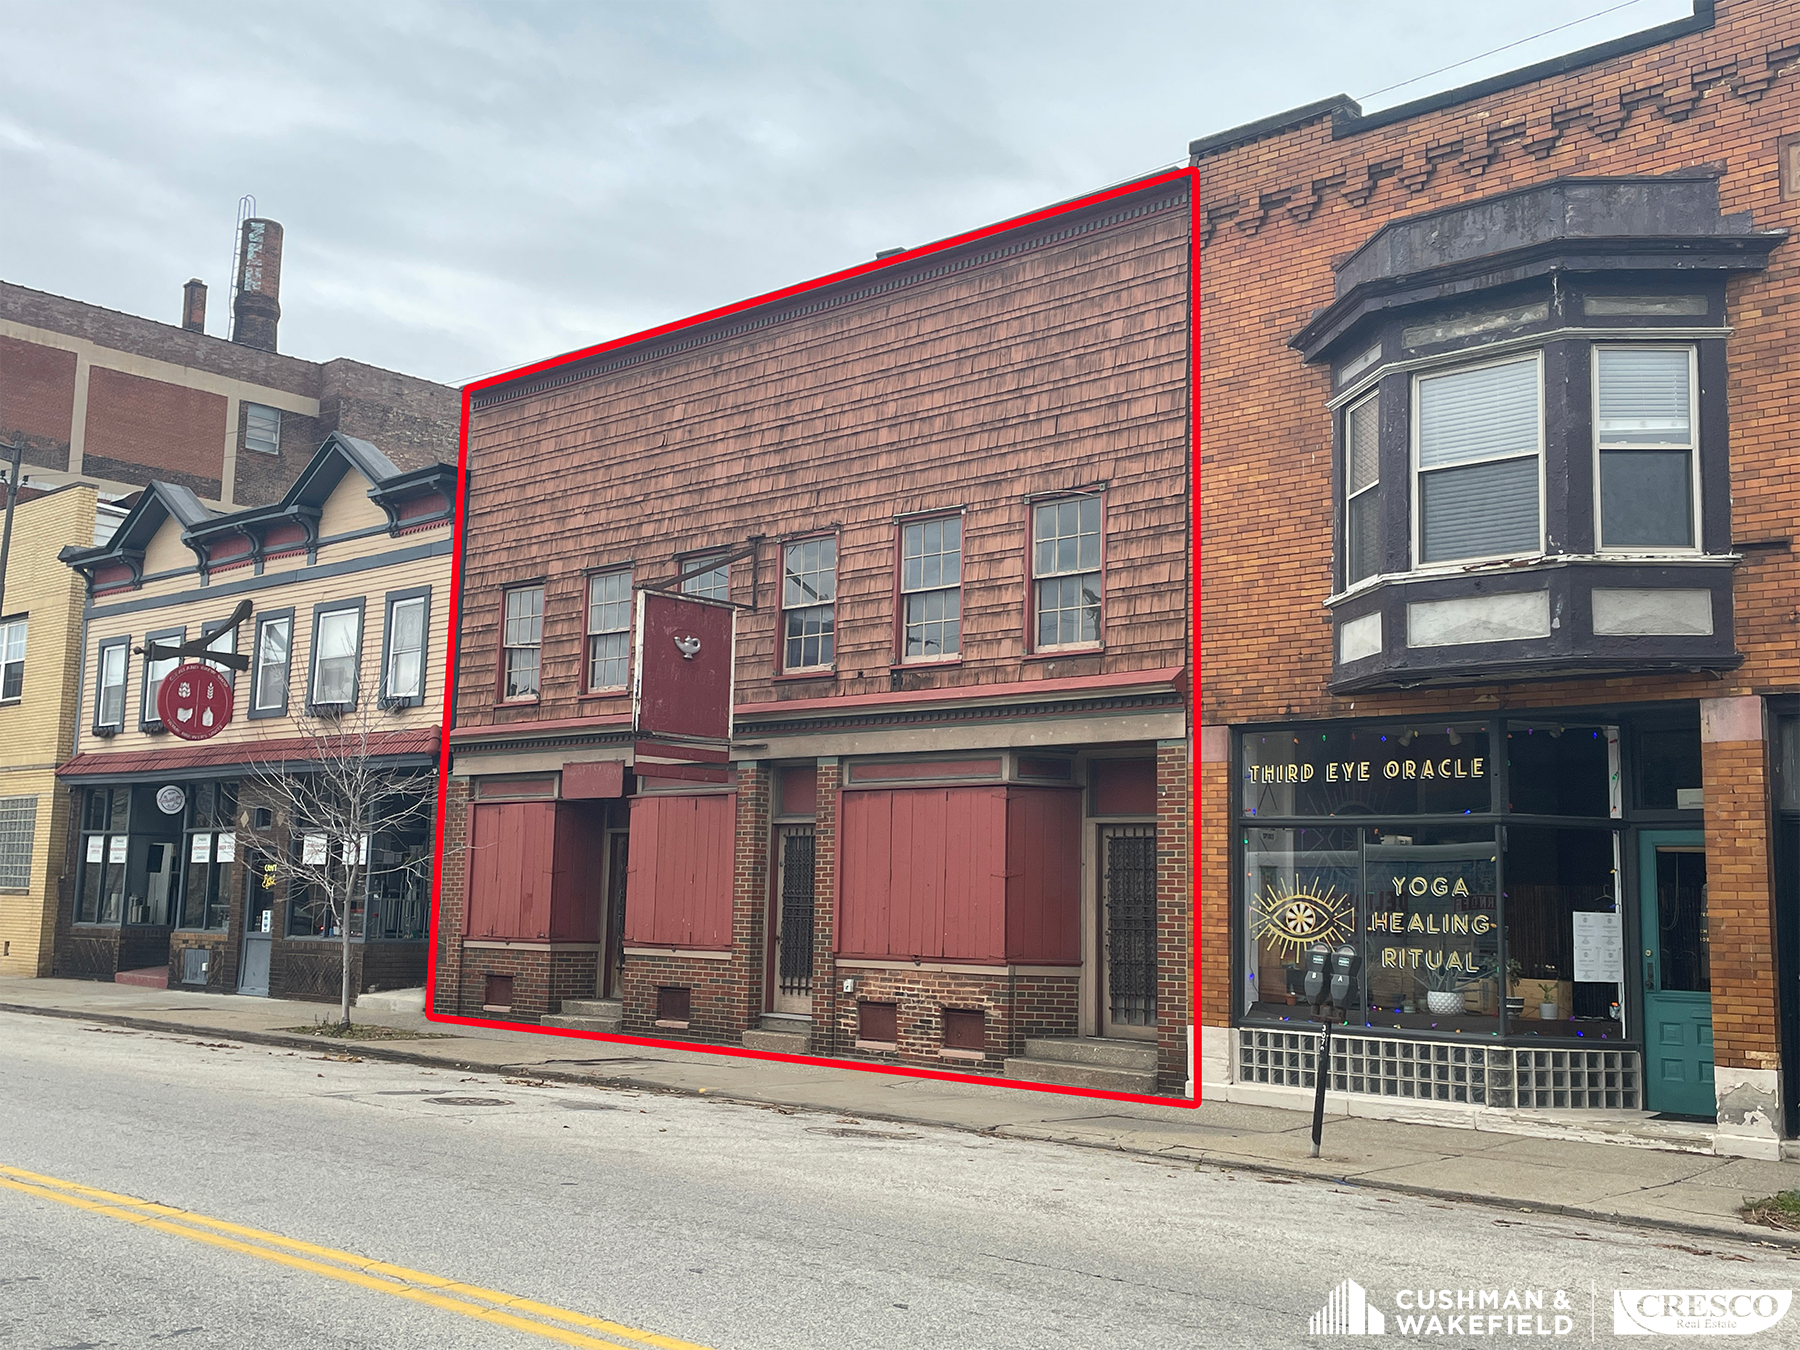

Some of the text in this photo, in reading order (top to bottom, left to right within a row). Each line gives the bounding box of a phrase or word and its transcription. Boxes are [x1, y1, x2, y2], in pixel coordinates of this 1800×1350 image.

[1248, 757, 1484, 783] THIRD EYE ORACLE
[1392, 876, 1469, 897] YOGA
[1372, 911, 1490, 935] HEALING
[1381, 947, 1480, 973] RITUAL
